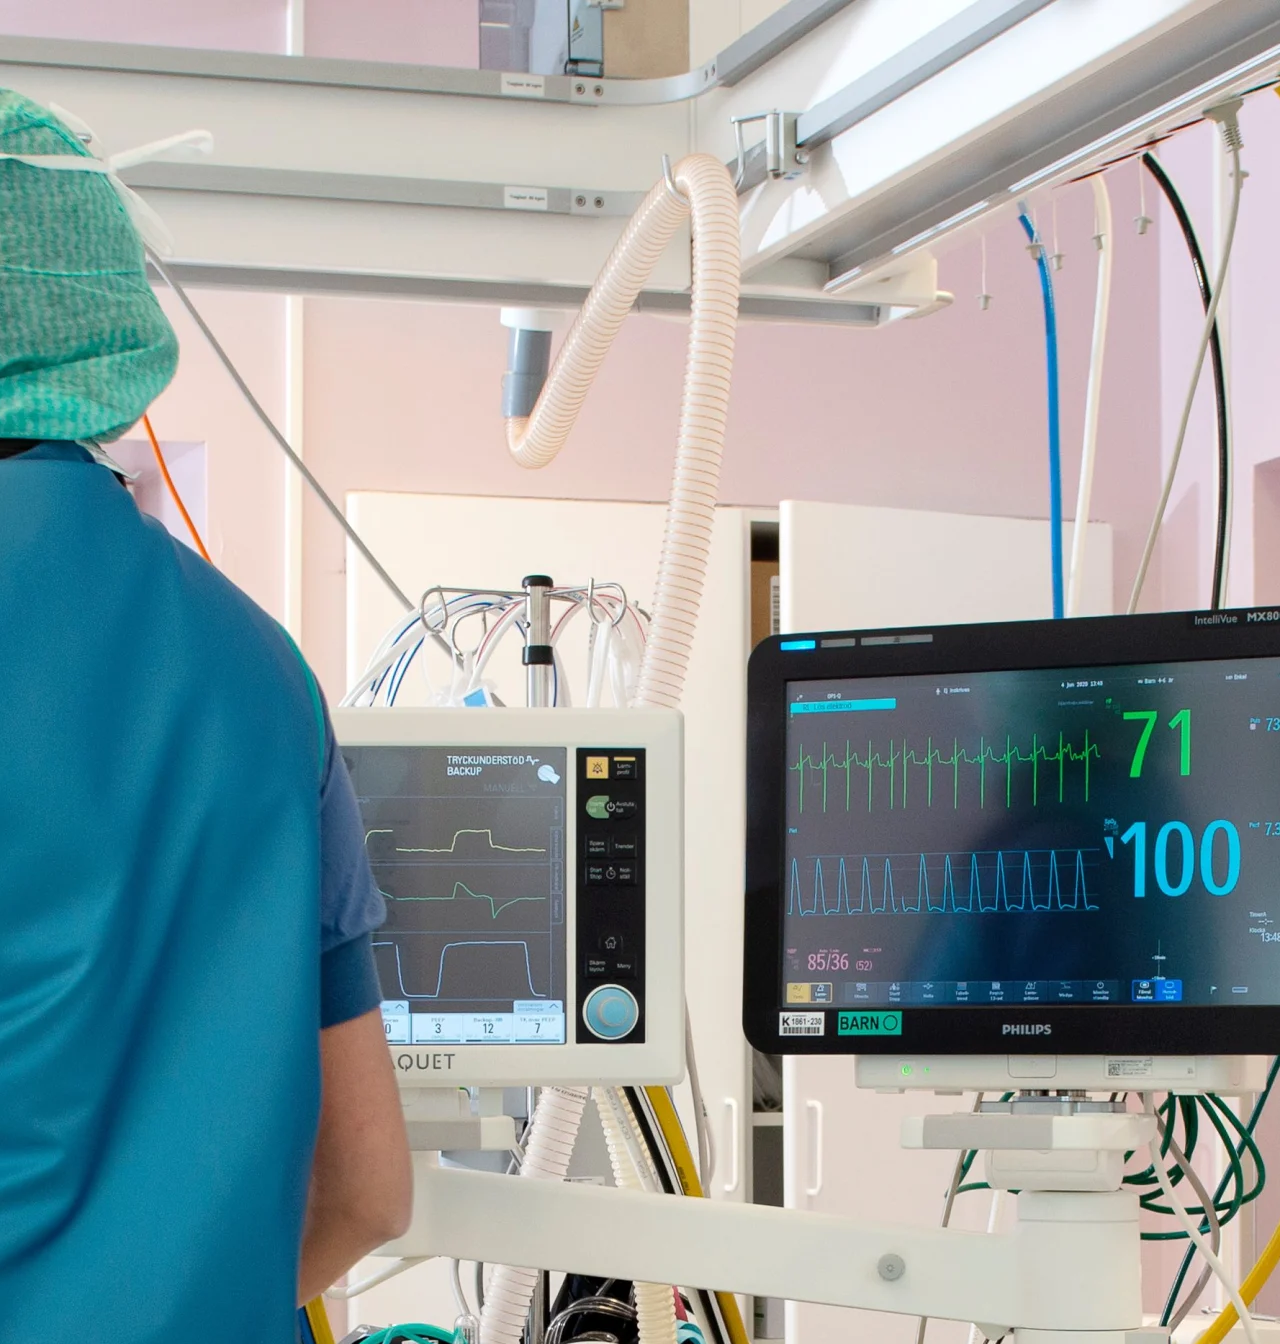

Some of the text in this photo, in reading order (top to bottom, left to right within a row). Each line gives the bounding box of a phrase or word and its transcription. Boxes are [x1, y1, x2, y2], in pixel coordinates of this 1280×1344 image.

[1194, 614, 1238, 626] IntelliVue
[1265, 718, 1280, 731] 73
[1123, 709, 1191, 778] 71
[447, 755, 525, 765] TRYCKUNDERSTÖD
[447, 766, 483, 776] BACKUP
[1120, 819, 1241, 898] 100
[807, 953, 873, 971] 85/36 (52)
[781, 1016, 822, 1026] K 1861-230
[840, 1016, 879, 1030] BARN
[435, 1023, 442, 1034] 3
[483, 1023, 494, 1034] 12
[535, 1023, 541, 1034] 7
[1002, 1024, 1052, 1035] PHILIPS
[392, 1053, 456, 1072] QUET
